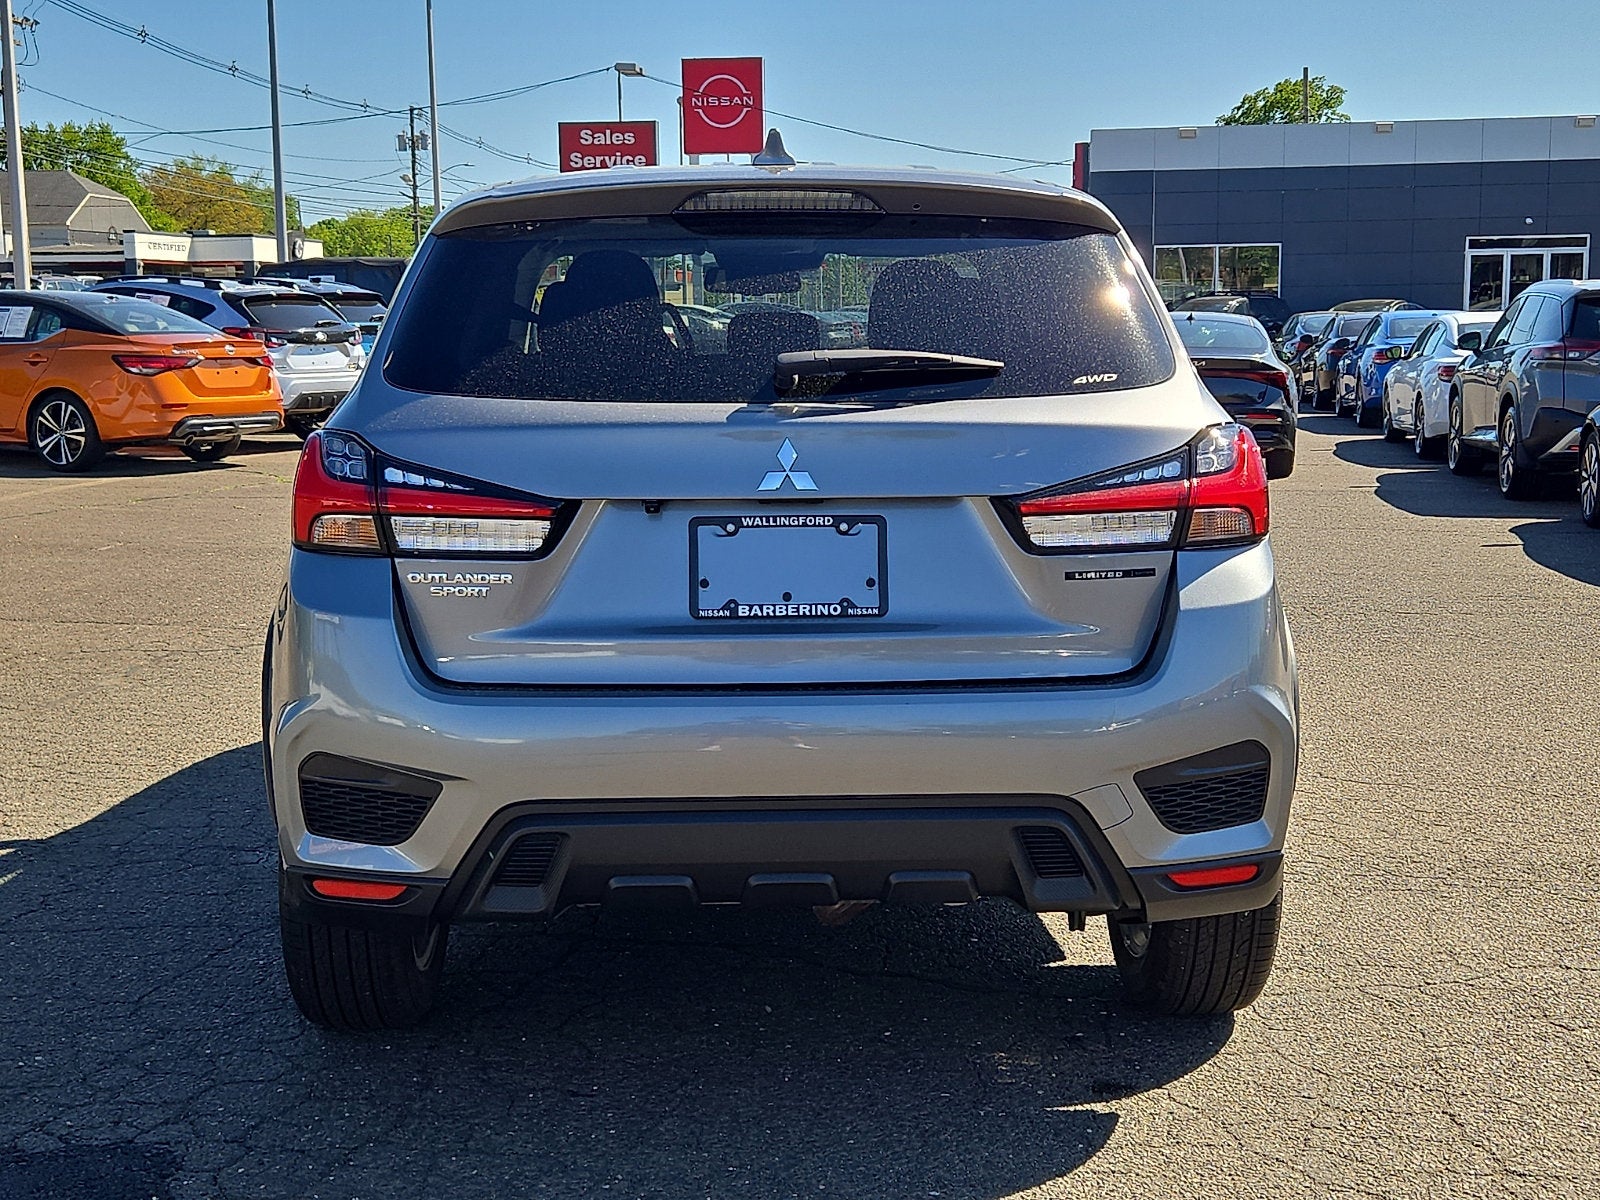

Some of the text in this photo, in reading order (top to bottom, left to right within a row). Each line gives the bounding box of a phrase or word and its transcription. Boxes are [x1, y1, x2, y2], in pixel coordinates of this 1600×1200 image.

[691, 96, 754, 107] NISSAN
[579, 129, 636, 145] Sales
[569, 151, 647, 168] Service
[147, 242, 187, 252] CERTIFIED
[1073, 373, 1118, 385] 4WD
[741, 516, 834, 527] WALLINGFORD
[406, 573, 513, 585] OUTLANDER
[1074, 571, 1123, 580] LIMITED
[430, 586, 491, 598] SPORT
[699, 604, 879, 618] NISSAN BARBERINO NISSAN
